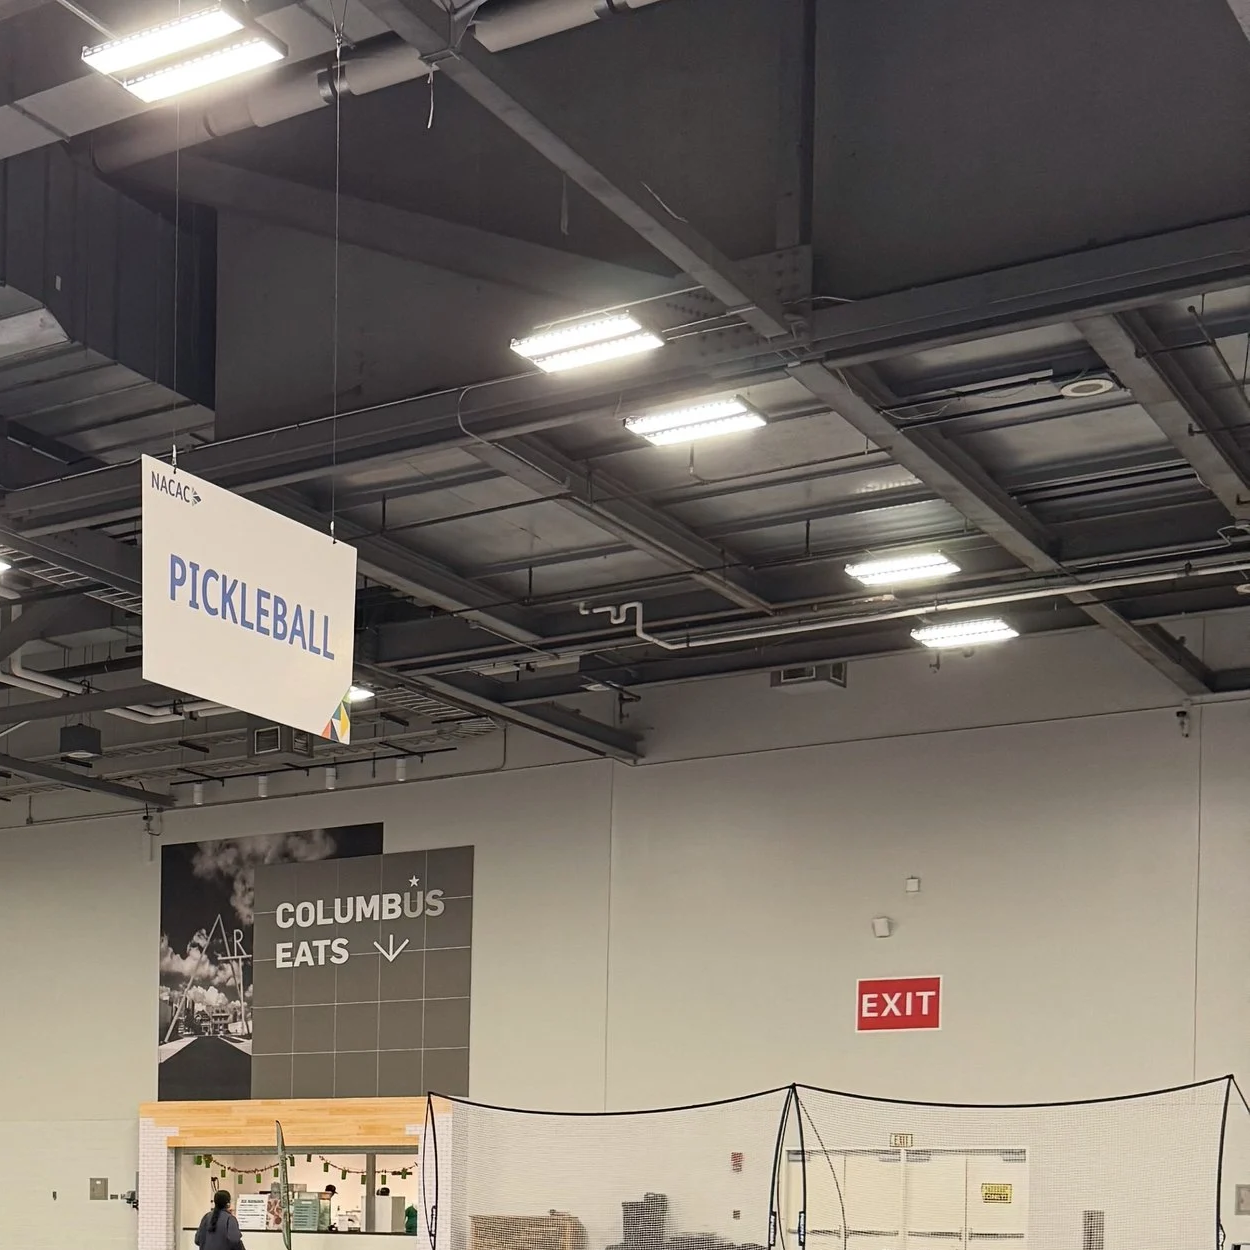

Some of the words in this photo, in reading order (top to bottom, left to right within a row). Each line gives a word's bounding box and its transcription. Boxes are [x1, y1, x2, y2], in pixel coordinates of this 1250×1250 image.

[151, 471, 190, 503] NACAC
[170, 554, 334, 660] PICKLEBALL
[276, 889, 445, 929] COLUMBUS
[276, 938, 349, 968] EATS
[861, 991, 936, 1018] EXIT
